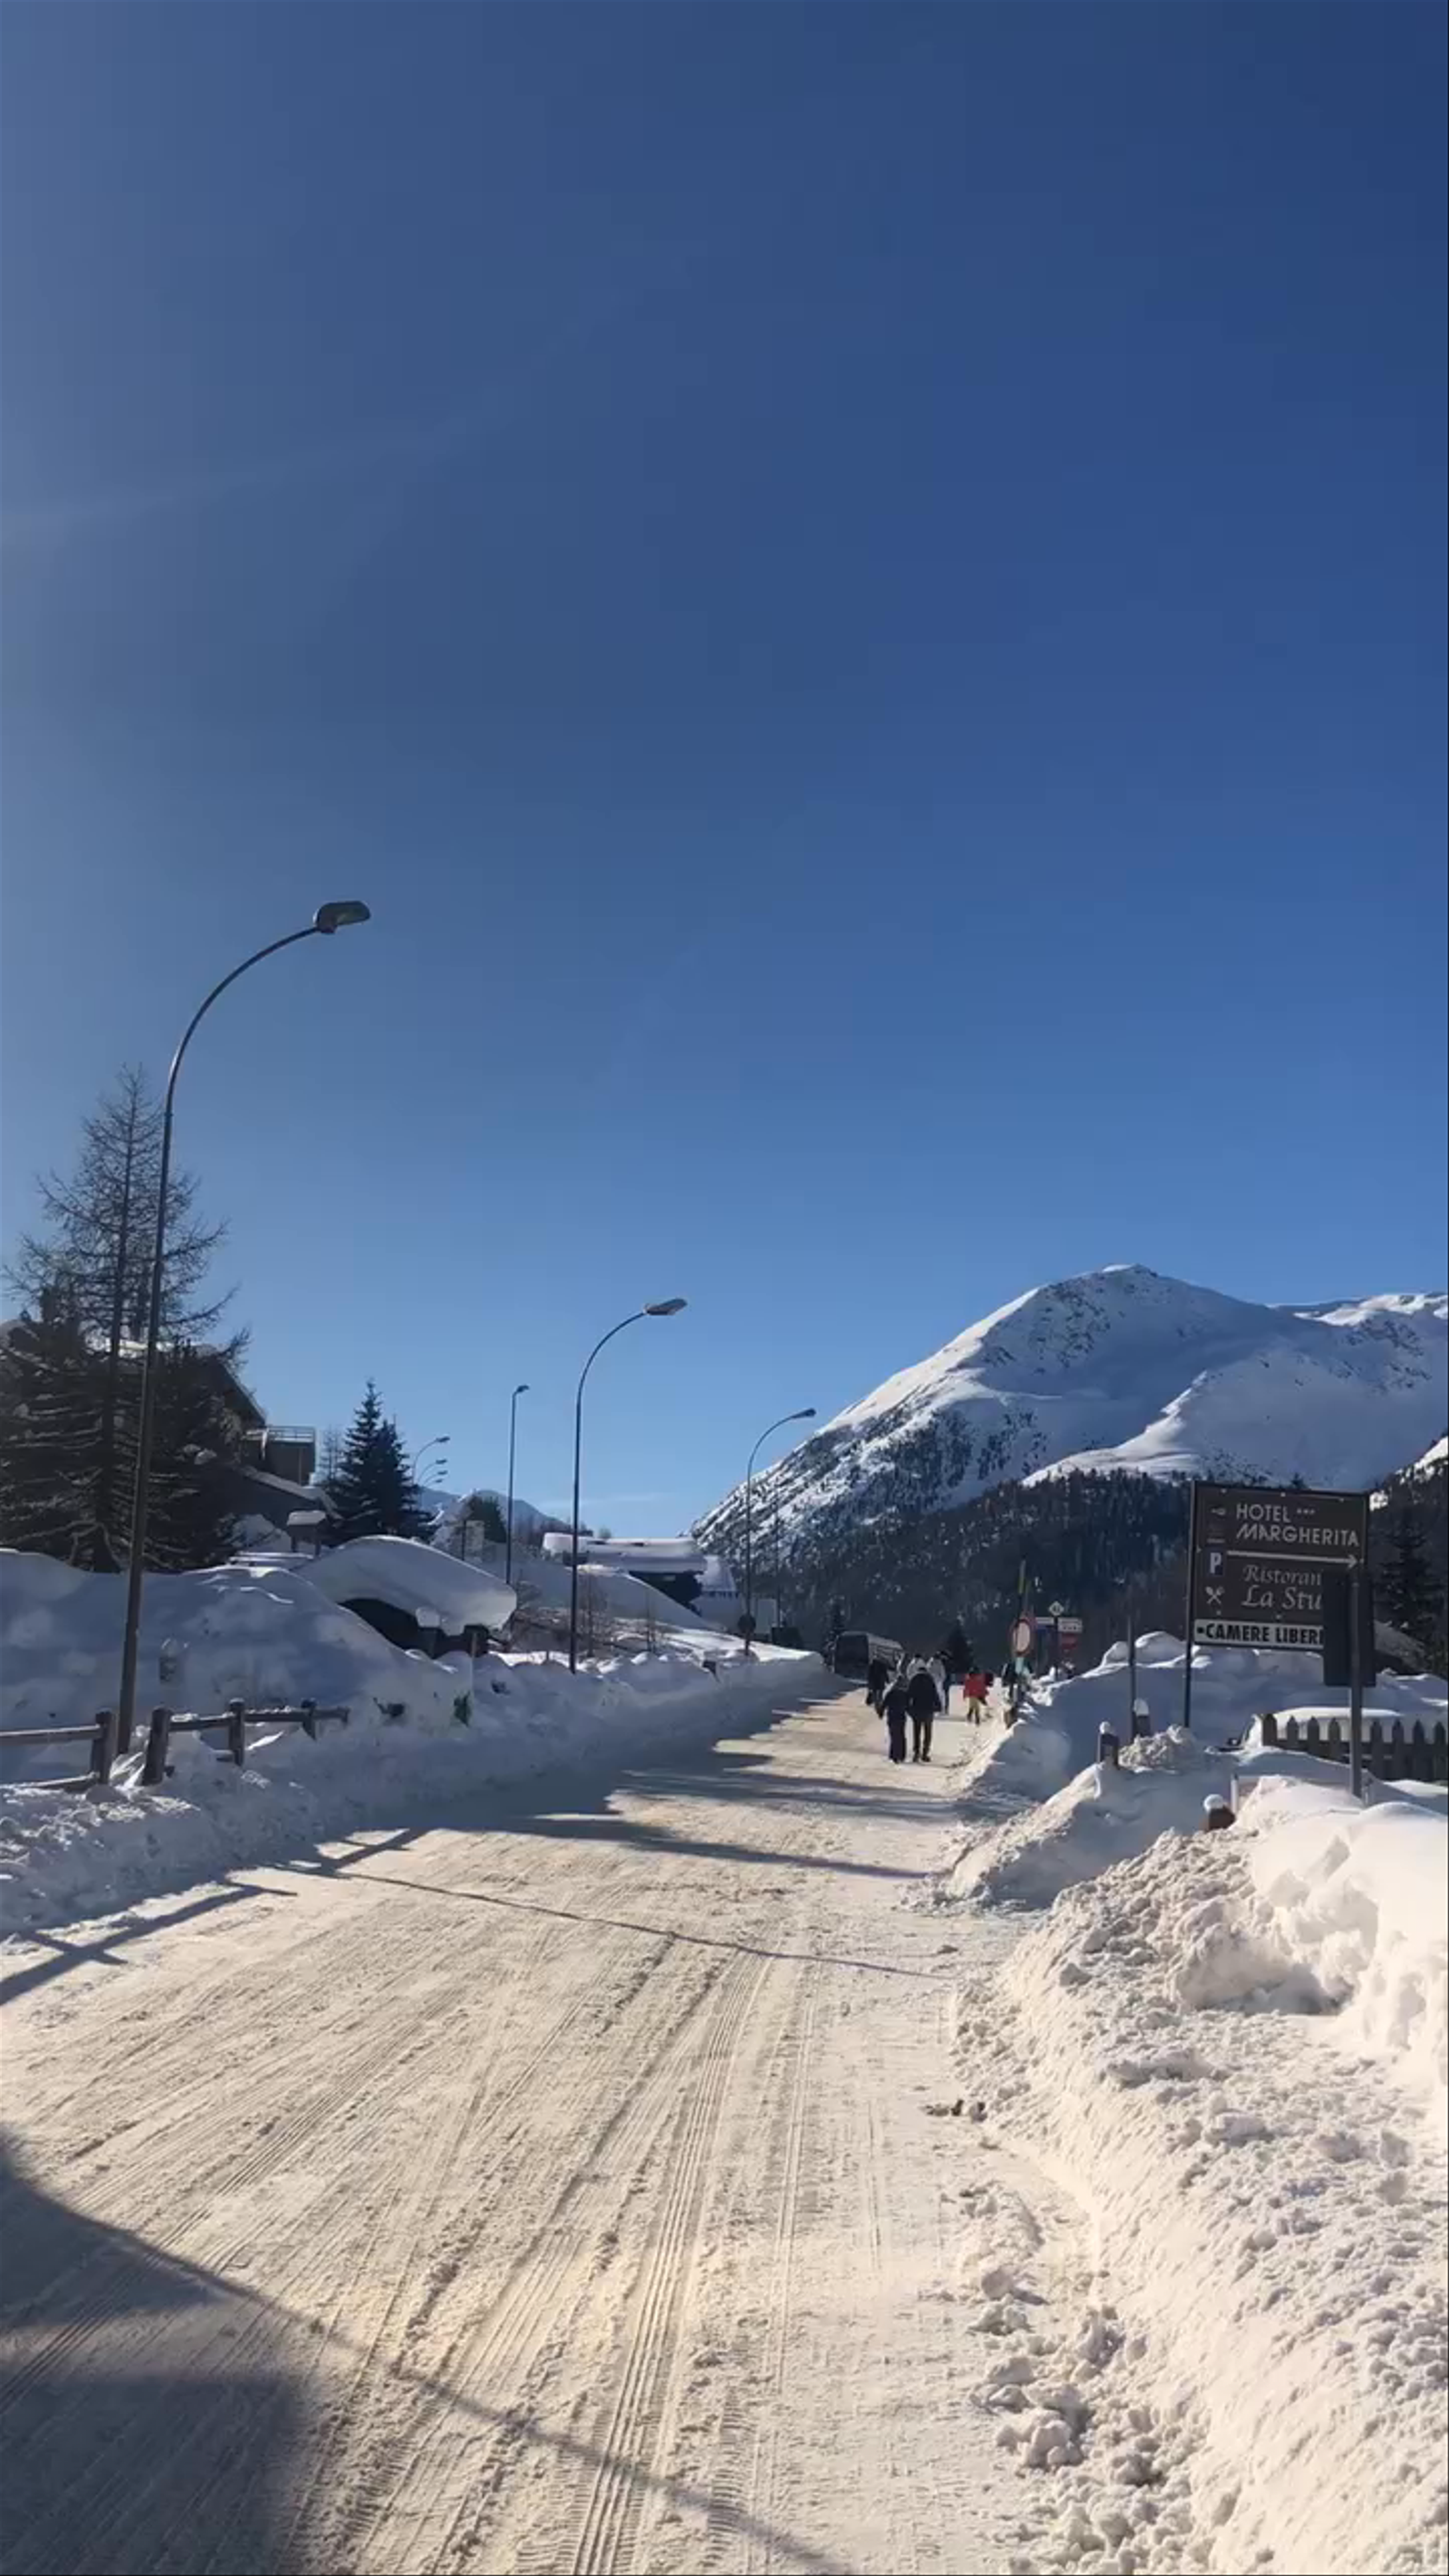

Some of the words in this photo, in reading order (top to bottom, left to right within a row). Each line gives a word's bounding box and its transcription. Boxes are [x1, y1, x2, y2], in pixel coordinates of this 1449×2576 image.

[1237, 1504, 1291, 1523] HOTEL
[1237, 1523, 1359, 1546] MARGHERITA
[1210, 1553, 1222, 1574] P
[1243, 1564, 1321, 1585] Ristoran
[1241, 1584, 1273, 1607] La
[1282, 1586, 1321, 1610] Stu
[1206, 1623, 1270, 1642] CAMERE
[1275, 1627, 1323, 1644] LIBER
